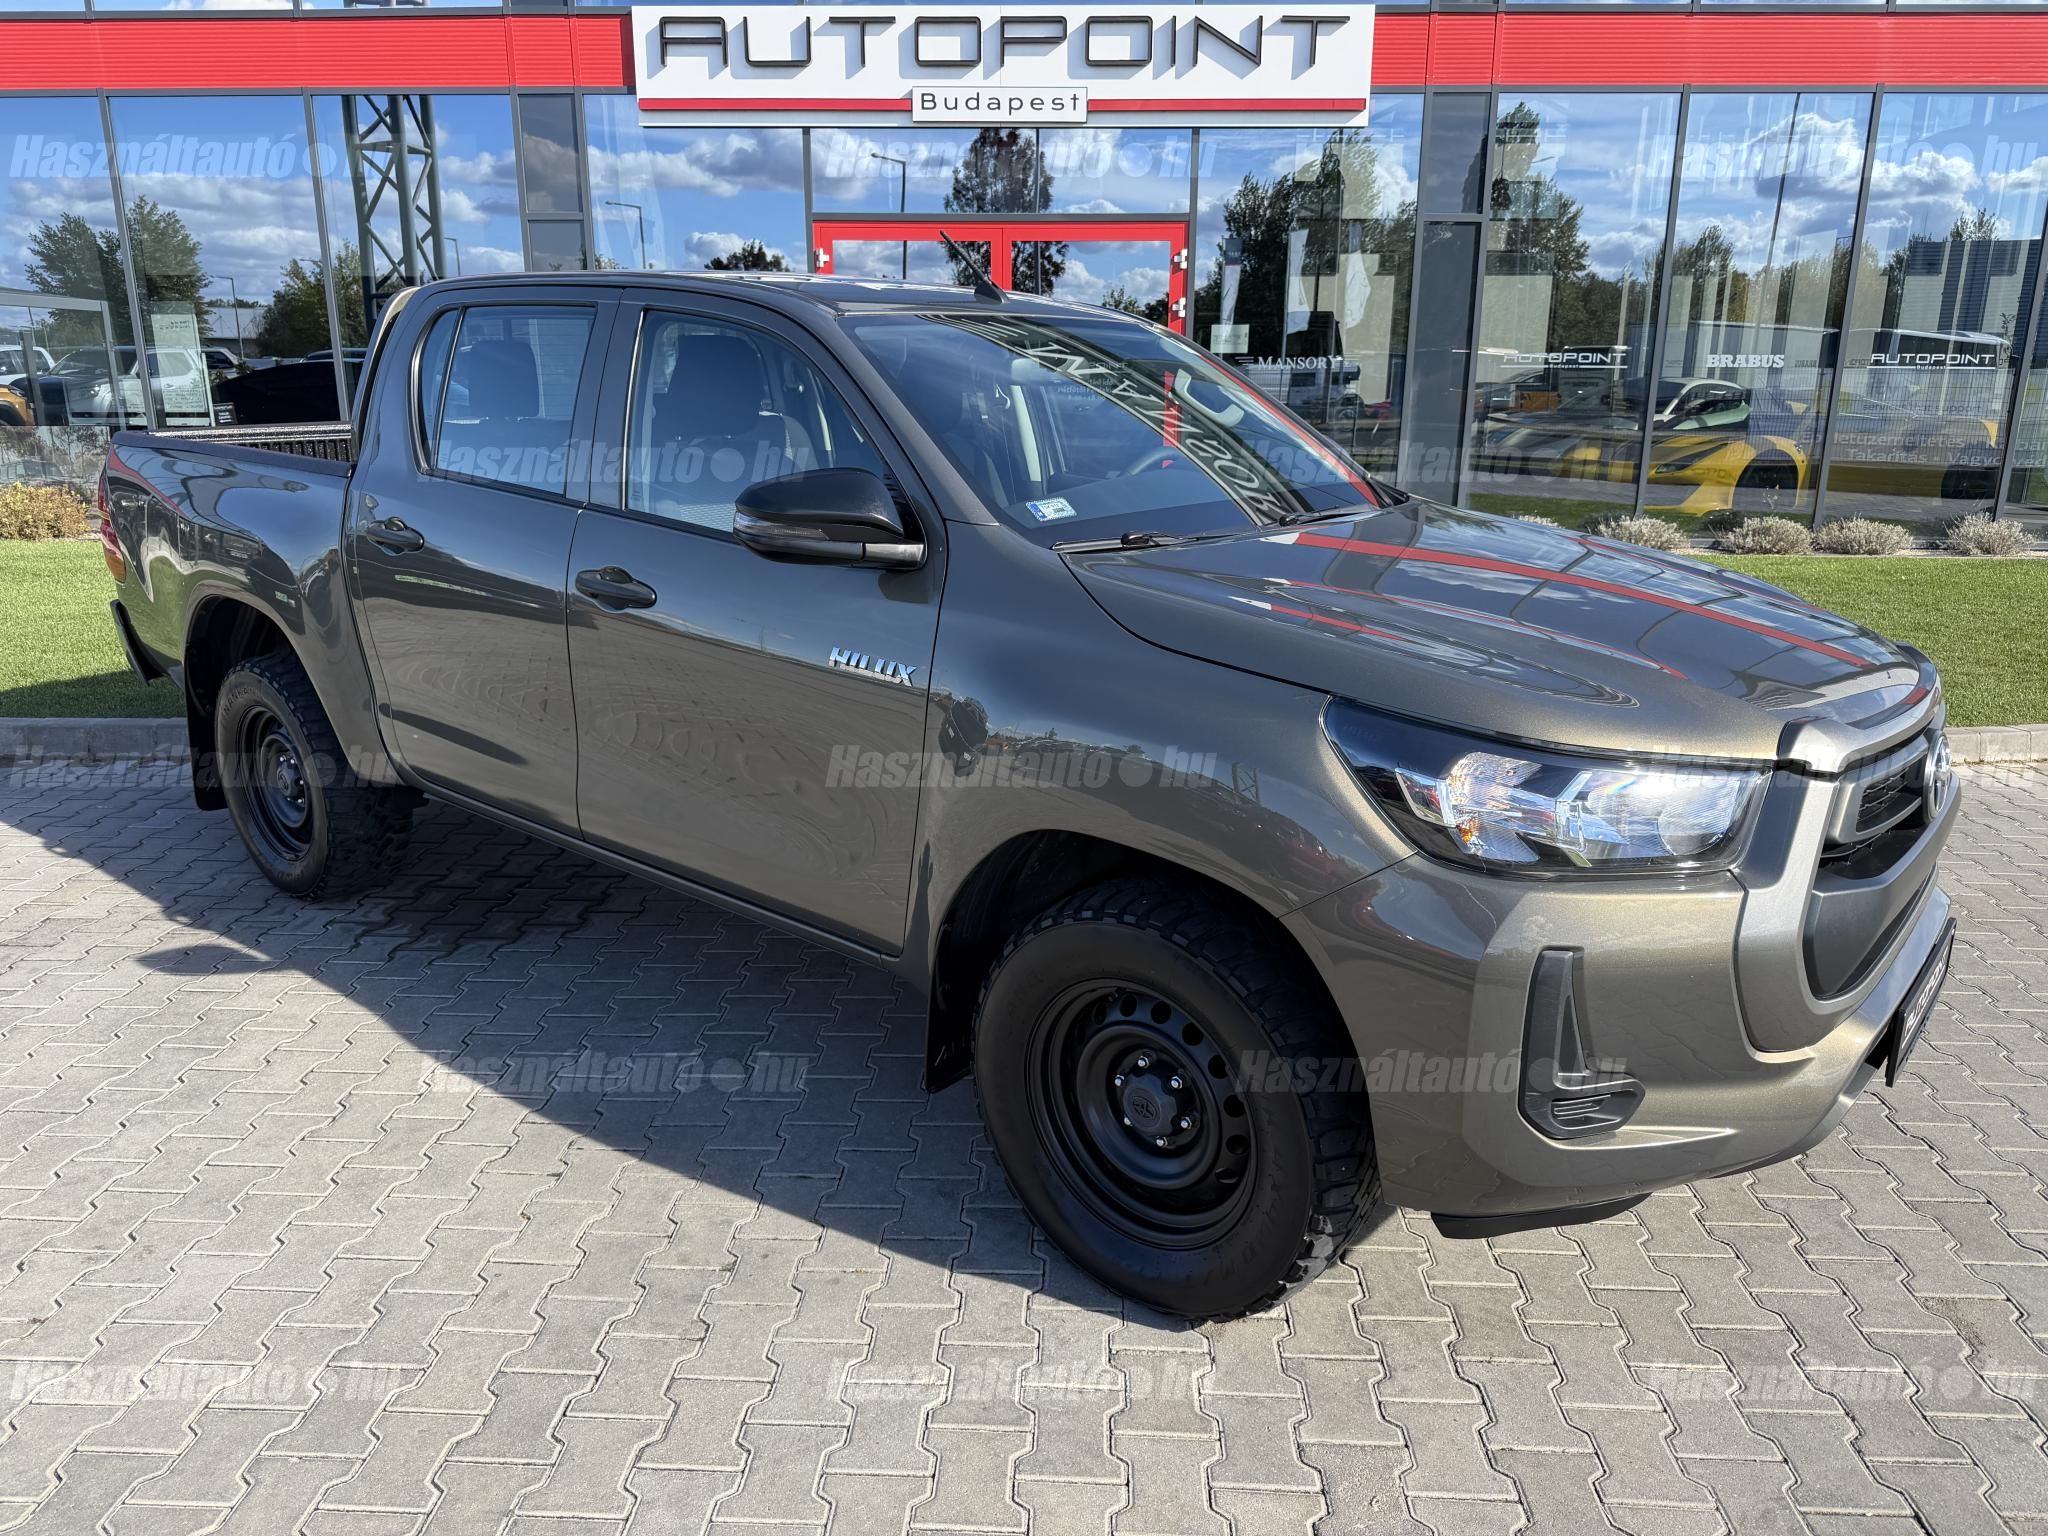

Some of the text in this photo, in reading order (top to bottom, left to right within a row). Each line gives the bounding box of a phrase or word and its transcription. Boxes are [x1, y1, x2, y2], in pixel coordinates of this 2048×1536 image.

[659, 15, 1350, 67] AUTOPOINT
[920, 92, 1081, 116] Budapest
[1258, 354, 1343, 370] MANSORY
[1706, 354, 1785, 368] BRABUS
[1871, 353, 1995, 364] AUTOPOINT
[828, 646, 917, 687] HILUX
